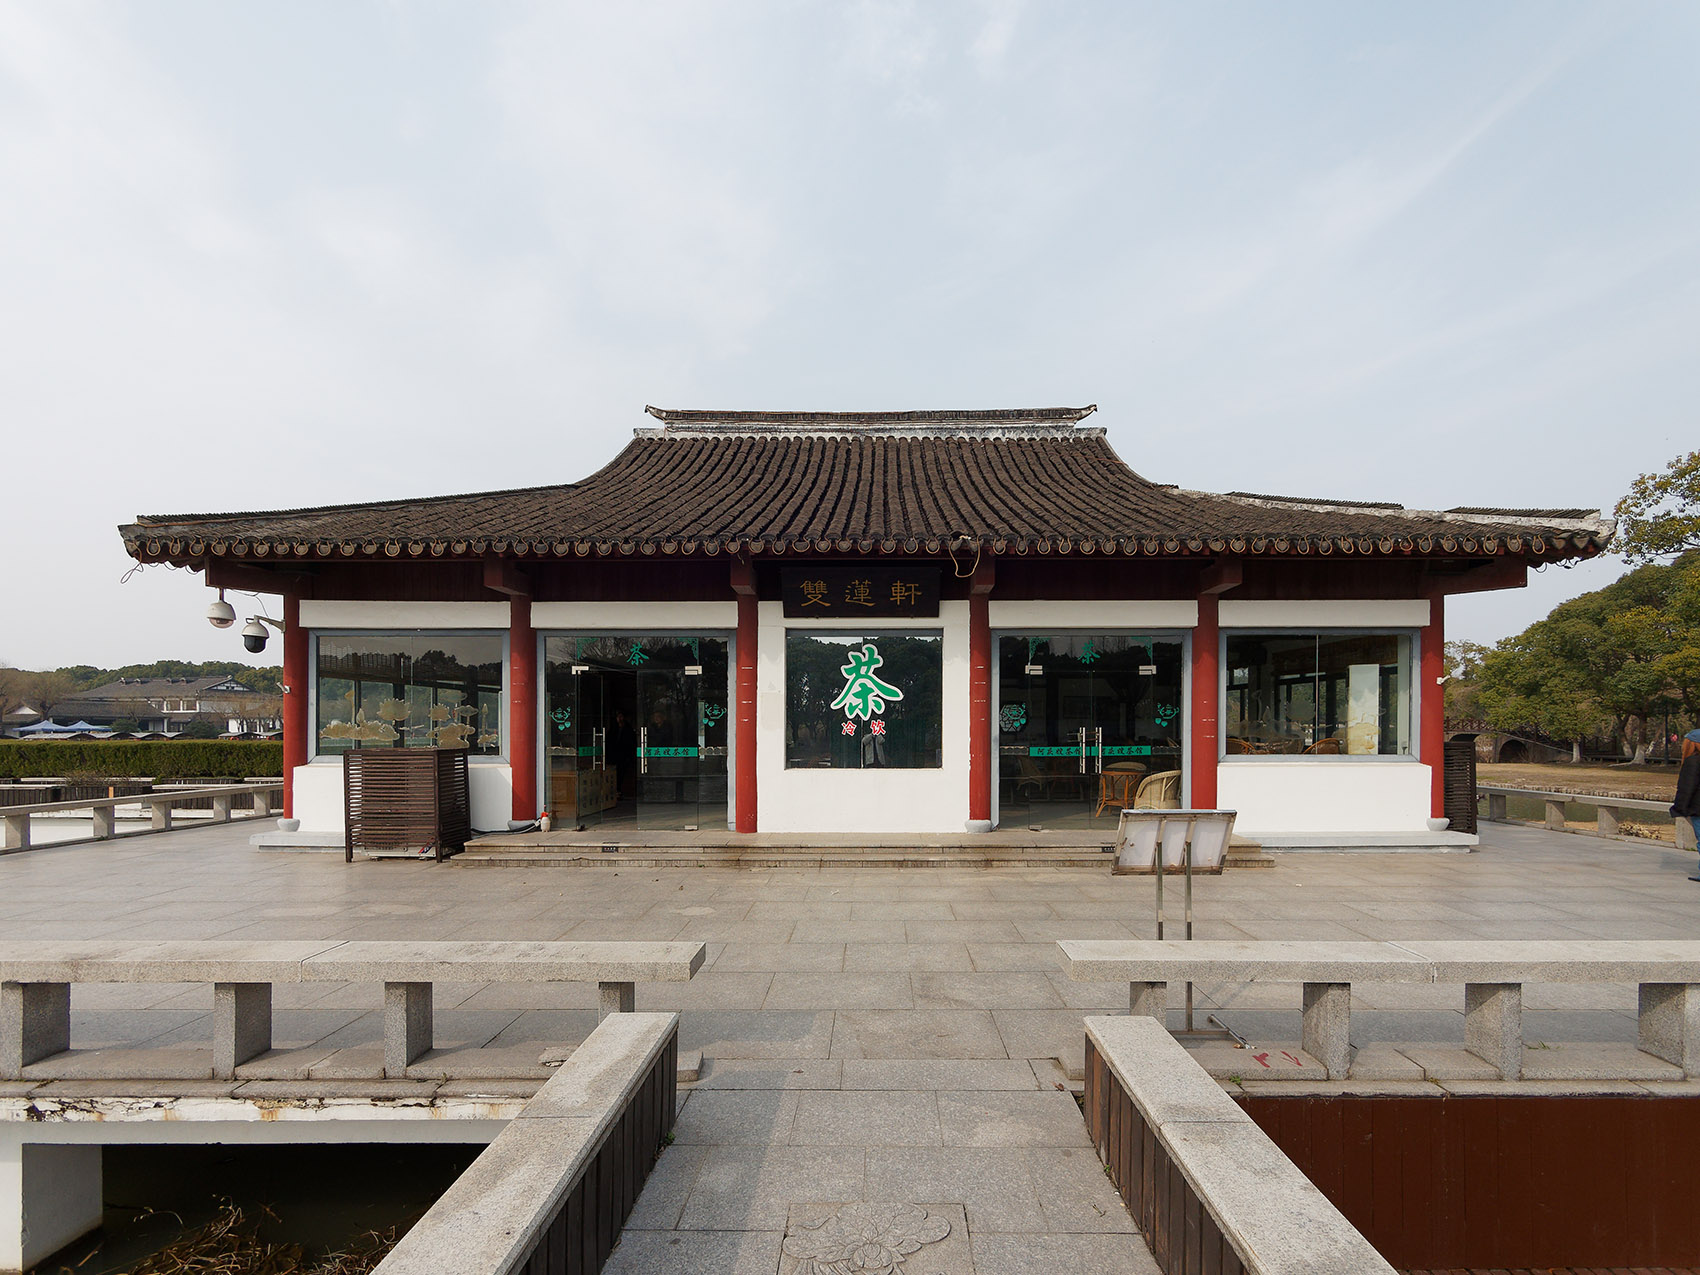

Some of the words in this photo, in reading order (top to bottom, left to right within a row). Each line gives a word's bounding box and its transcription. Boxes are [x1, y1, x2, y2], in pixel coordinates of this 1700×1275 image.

[626, 641, 650, 666] 茶
[1077, 639, 1101, 665] 茶
[831, 644, 903, 720] 茶
[841, 719, 887, 736] 冷饮
